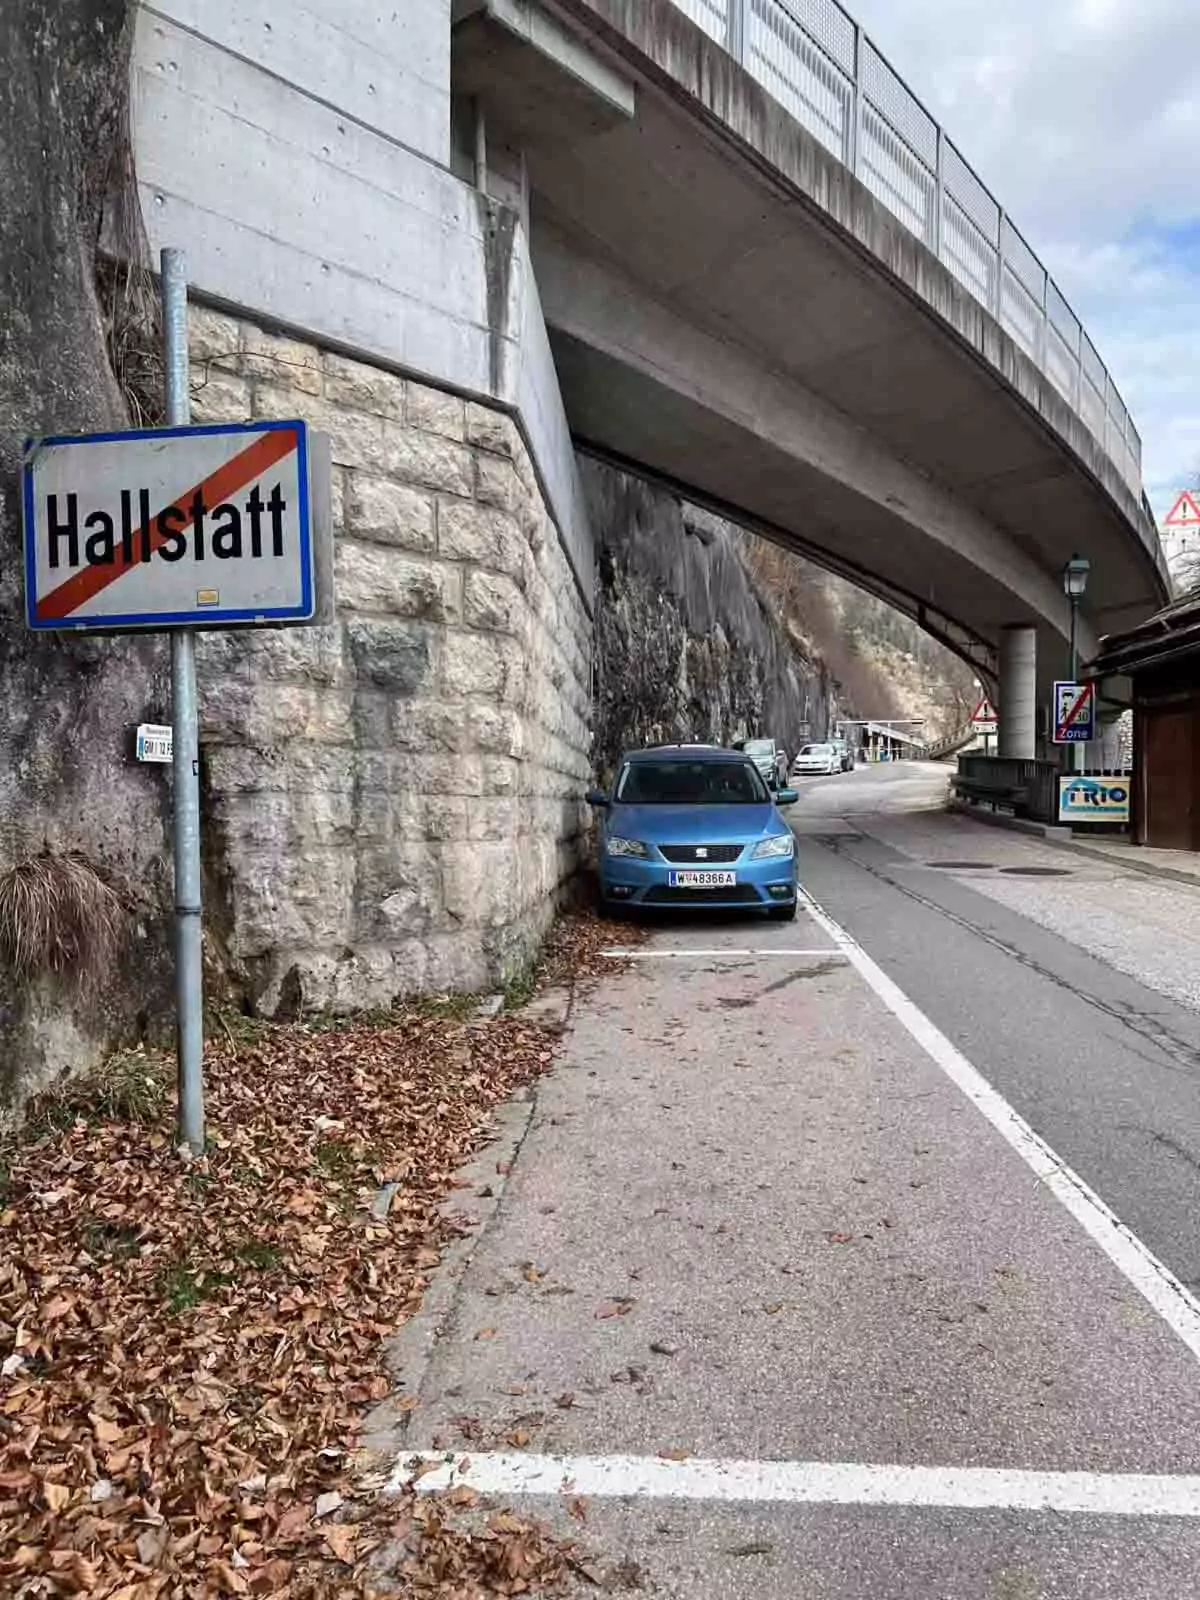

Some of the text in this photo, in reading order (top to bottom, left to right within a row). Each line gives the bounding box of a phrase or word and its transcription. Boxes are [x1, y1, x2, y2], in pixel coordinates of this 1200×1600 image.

[46, 482, 286, 568] Hallstatt
[1059, 728, 1089, 738] Zone
[1066, 786, 1127, 806] TRIO
